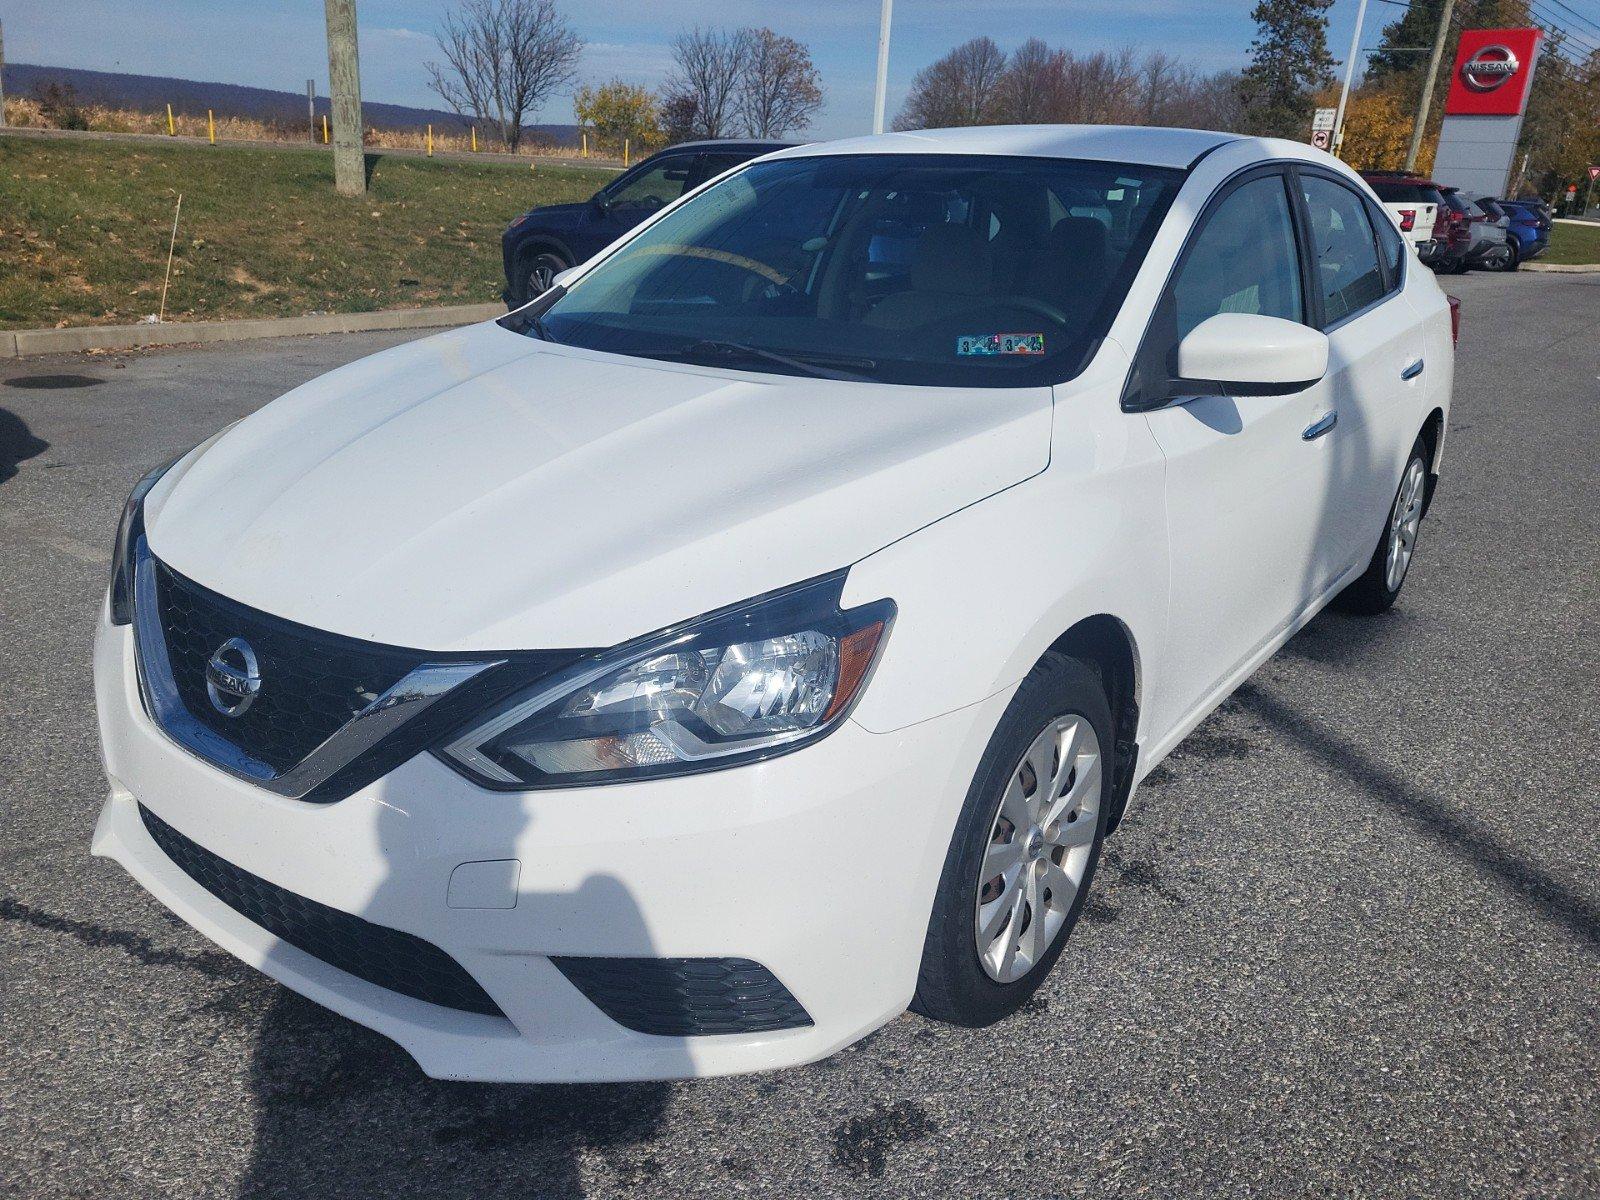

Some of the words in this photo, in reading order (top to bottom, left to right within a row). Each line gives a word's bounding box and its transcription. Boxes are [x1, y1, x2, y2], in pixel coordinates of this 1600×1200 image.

[1468, 63, 1513, 72] NISSAN
[963, 341, 970, 352] 3
[1006, 339, 1013, 351] 3
[208, 668, 251, 695] NISSAN
